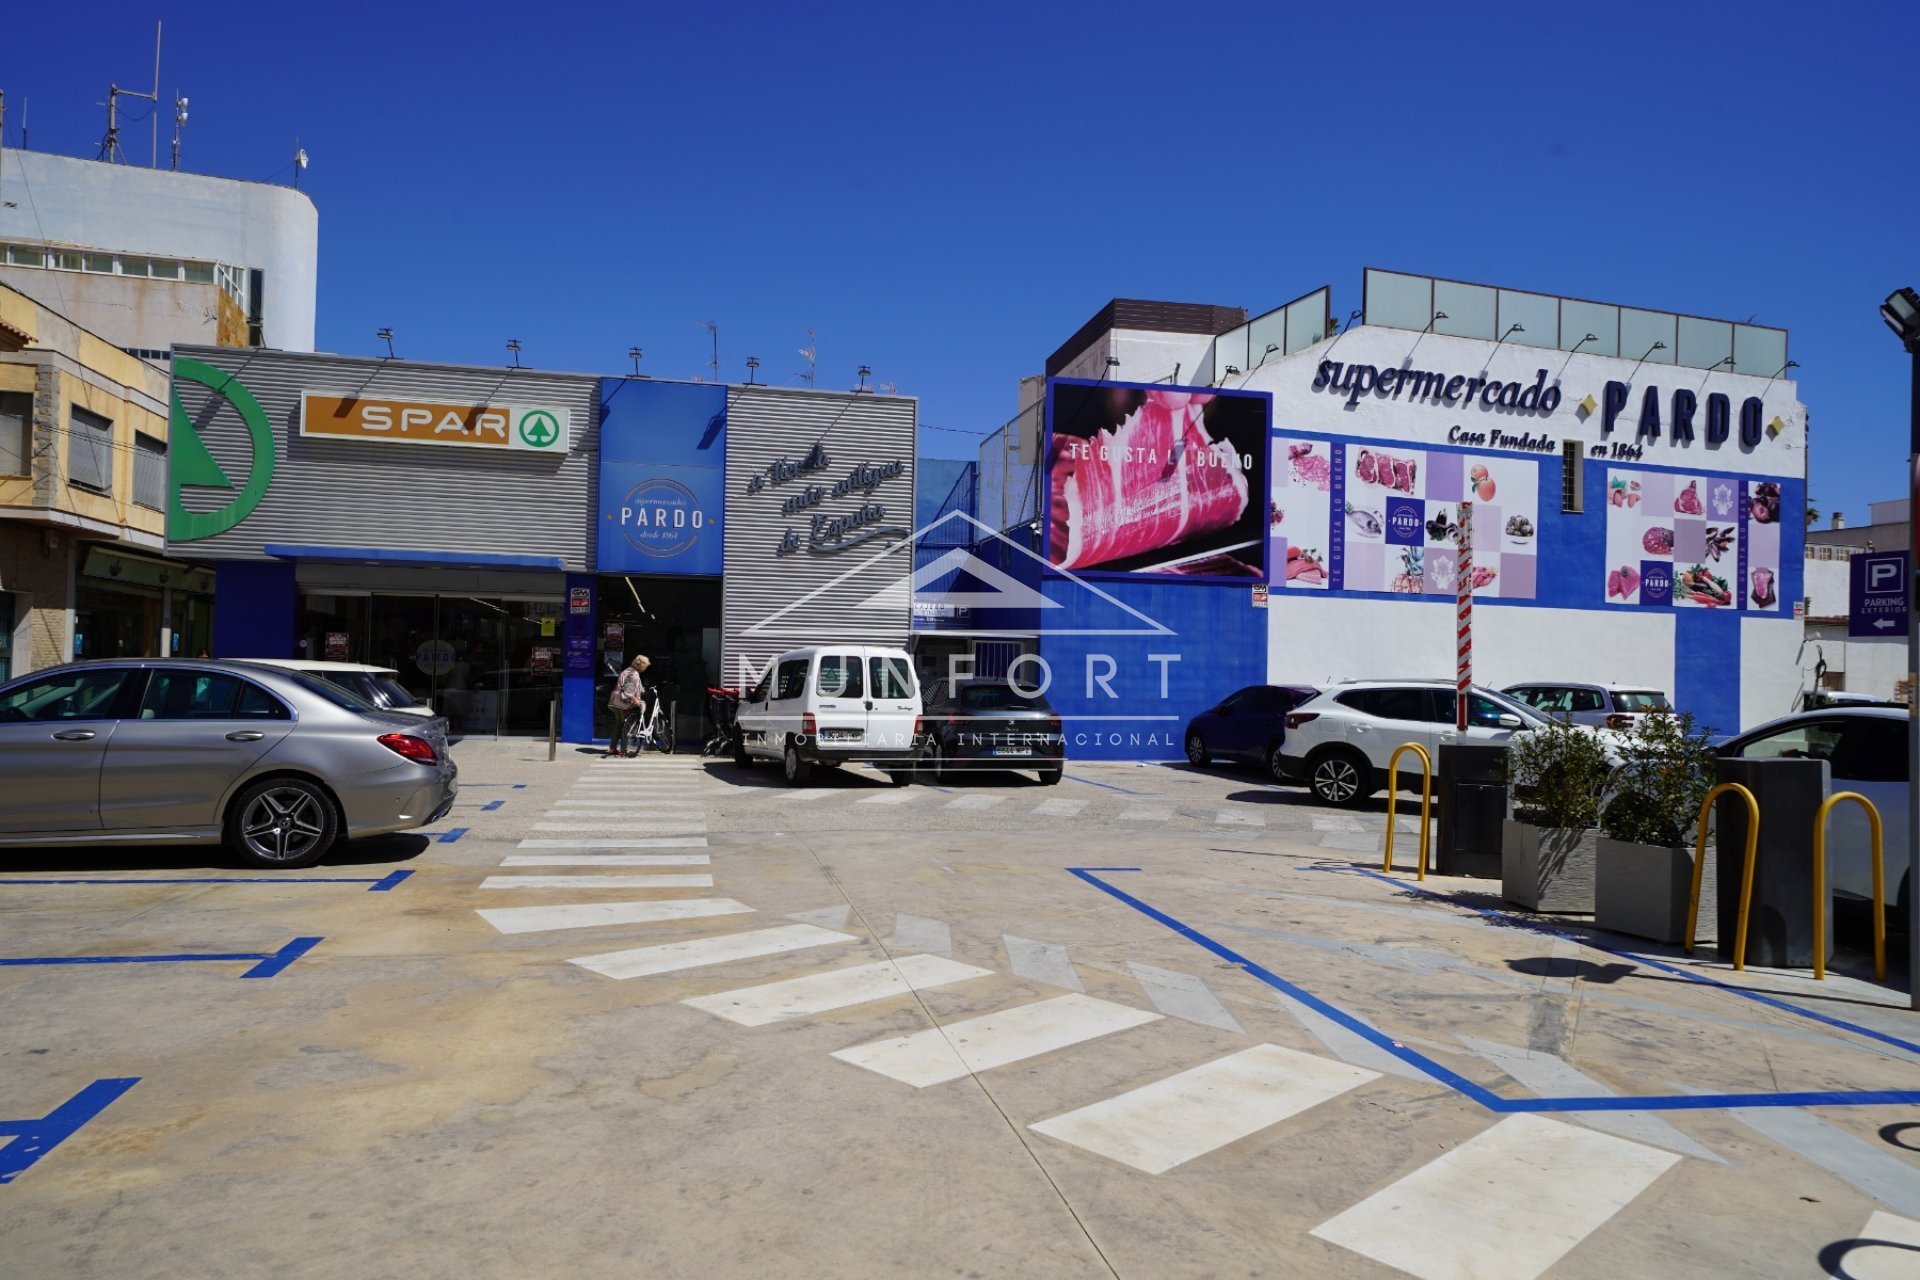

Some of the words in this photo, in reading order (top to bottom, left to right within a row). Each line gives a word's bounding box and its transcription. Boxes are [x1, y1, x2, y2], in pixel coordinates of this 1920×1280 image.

[1314, 359, 1562, 412] supermercado
[361, 406, 506, 437] SPAR
[1604, 380, 1764, 447] PARDO
[1070, 442, 1090, 460] TE
[1100, 447, 1157, 463] GUSTA
[1449, 426, 1486, 444] Casa
[1489, 429, 1556, 451] Fundada
[1590, 444, 1607, 456] en
[1611, 442, 1643, 458] 1864
[1334, 449, 1342, 490] BUENO
[1334, 498, 1342, 512] LO
[621, 507, 703, 529] PARDO
[1392, 516, 1420, 527] PARDO
[1333, 521, 1342, 560] GUSTA
[1333, 569, 1341, 582] TE
[1645, 578, 1669, 588] PARDO
[1871, 564, 1897, 587] P
[1861, 606, 1907, 614] EXTERIOR
[1864, 597, 1904, 607] PARKING
